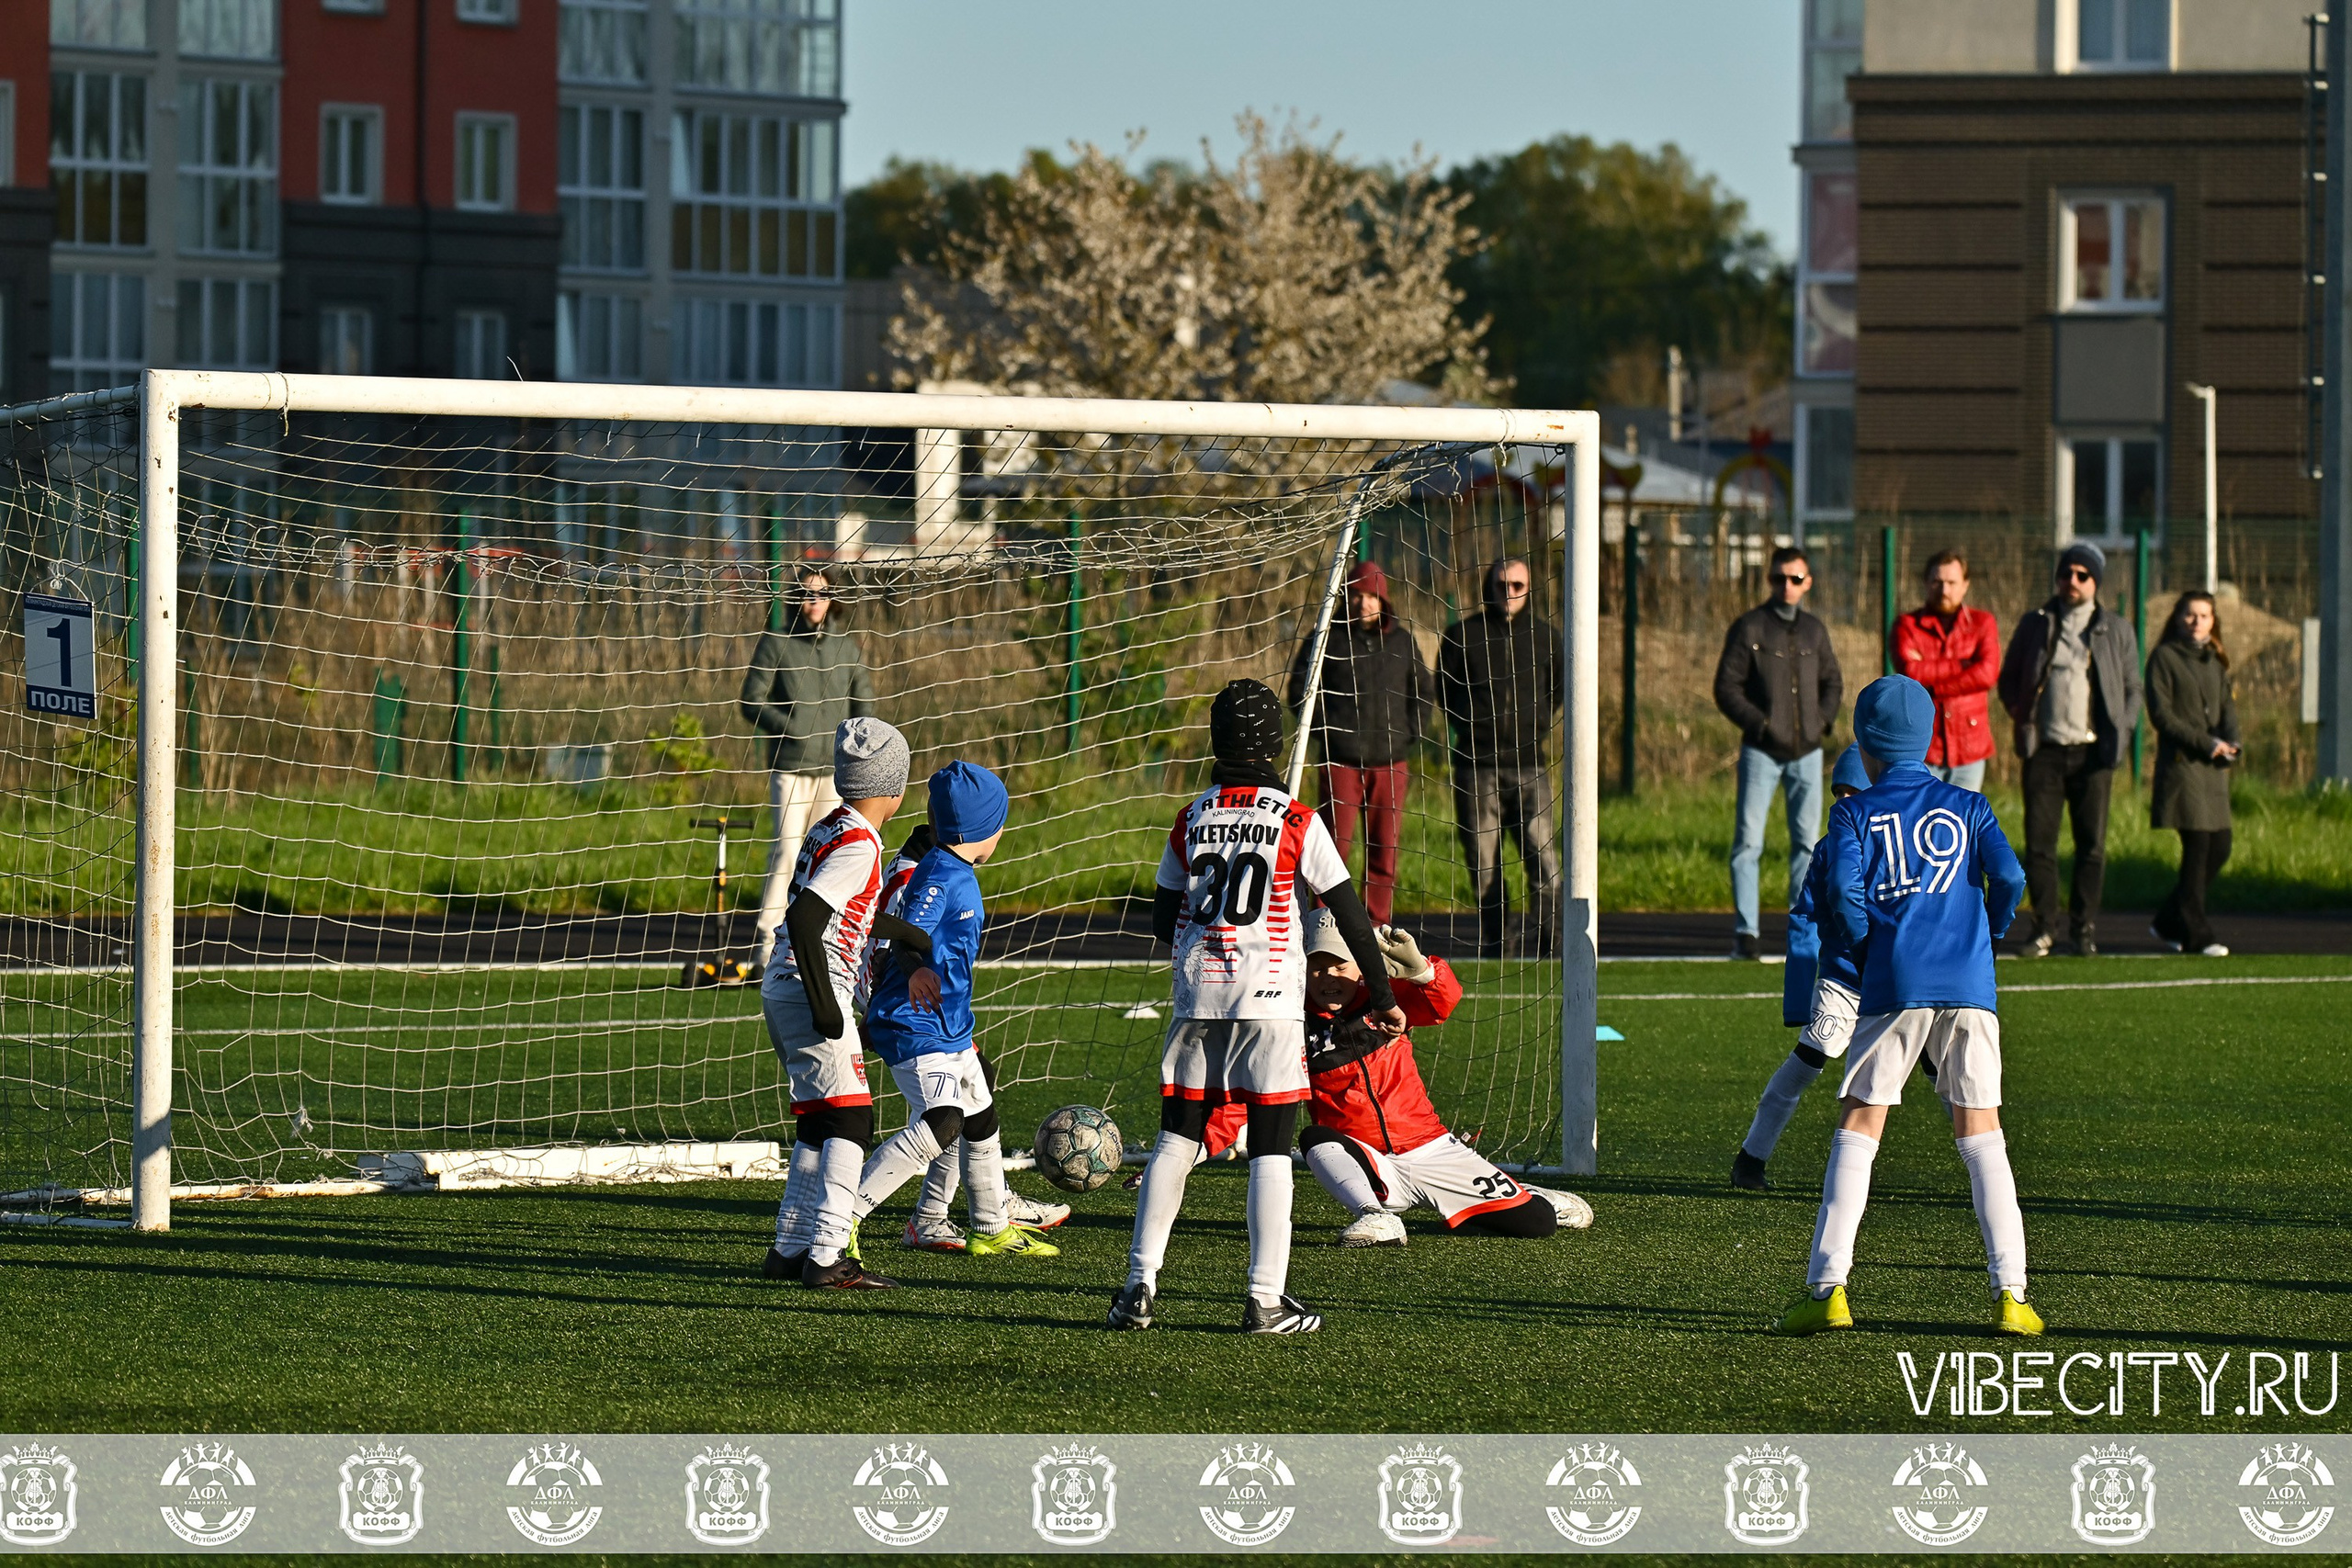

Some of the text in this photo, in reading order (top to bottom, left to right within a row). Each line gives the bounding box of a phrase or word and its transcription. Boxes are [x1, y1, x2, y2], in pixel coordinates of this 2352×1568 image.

[47, 617, 72, 688] 1
[30, 690, 91, 715] ПОЛЕ
[1201, 794, 1304, 829] ATHLETIC
[1212, 808, 1255, 818] KALININGRAD
[1870, 807, 1968, 901] 19
[1190, 852, 1269, 926] 30
[959, 908, 975, 920] JAKO
[1472, 1170, 1517, 1200] 25
